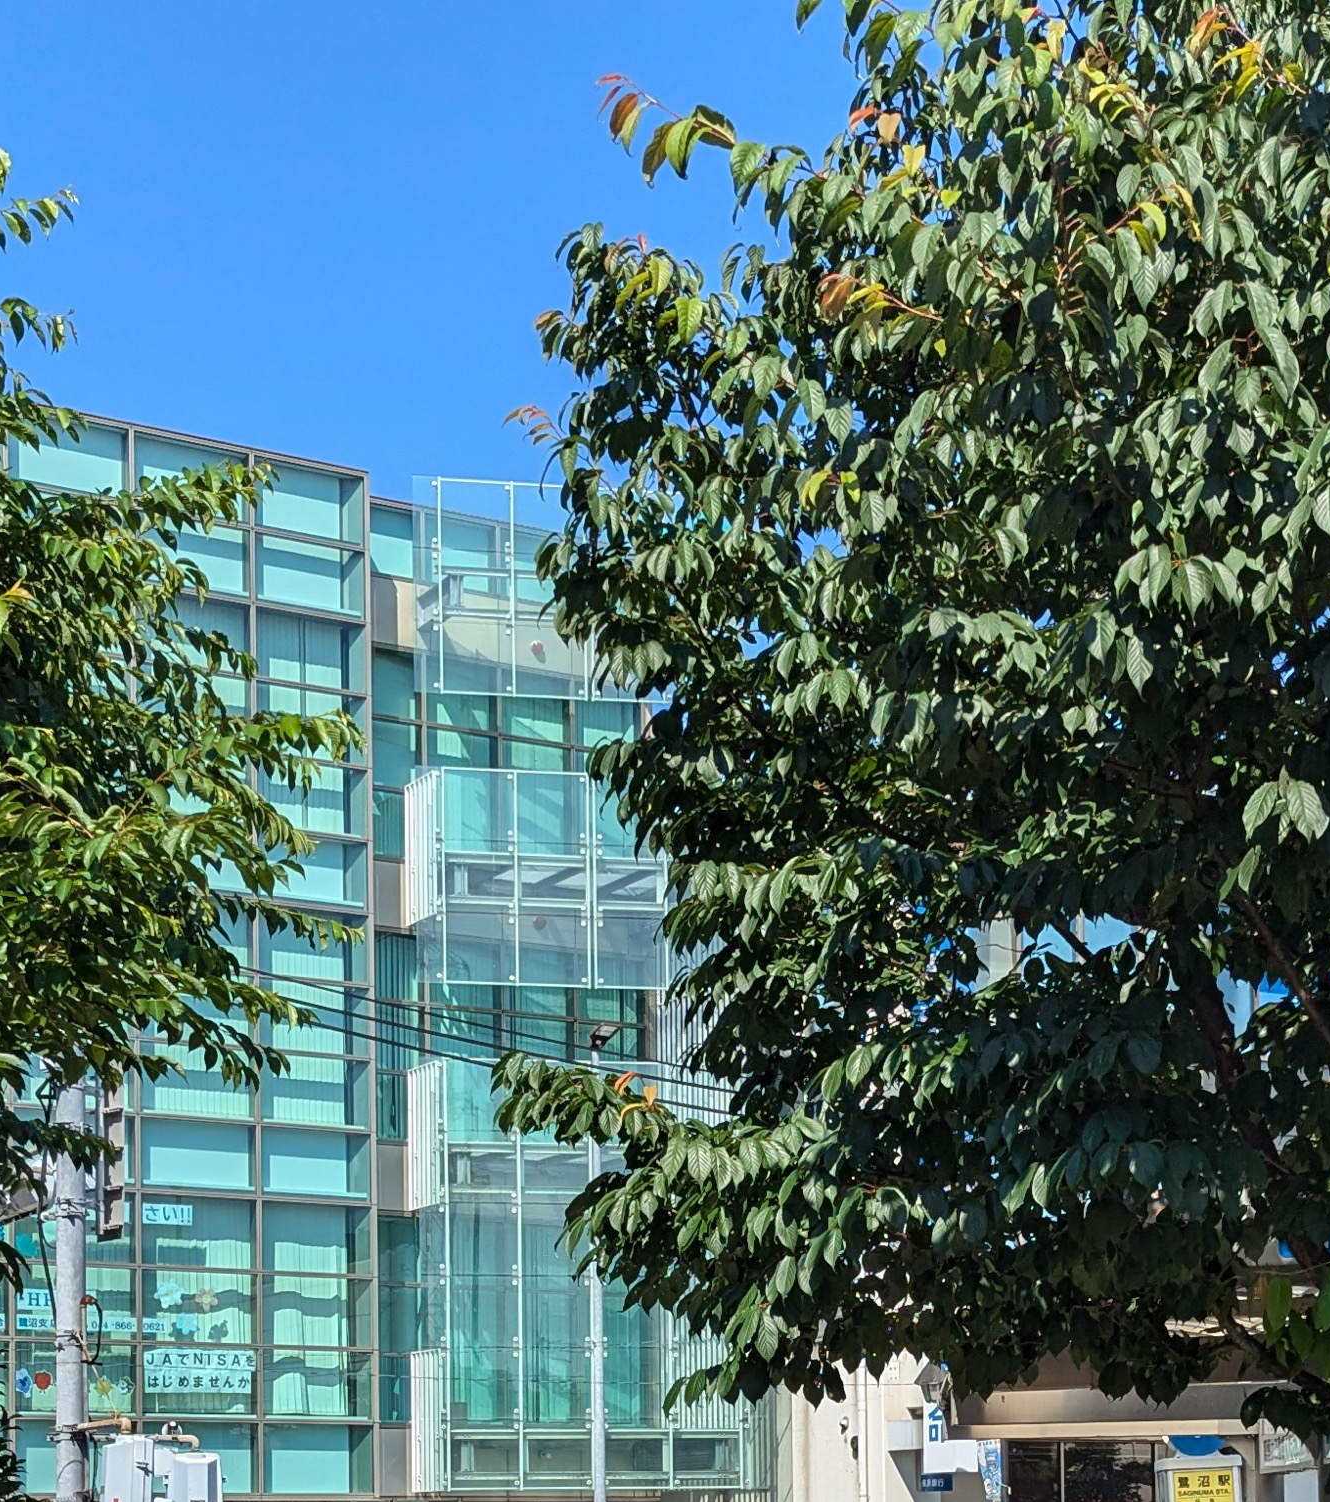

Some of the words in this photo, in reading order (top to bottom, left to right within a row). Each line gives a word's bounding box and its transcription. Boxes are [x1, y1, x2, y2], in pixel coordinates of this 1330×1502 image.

[147, 1375, 251, 1389] はじめませんか
[1177, 1474, 1231, 1489] 鷺沼駅
